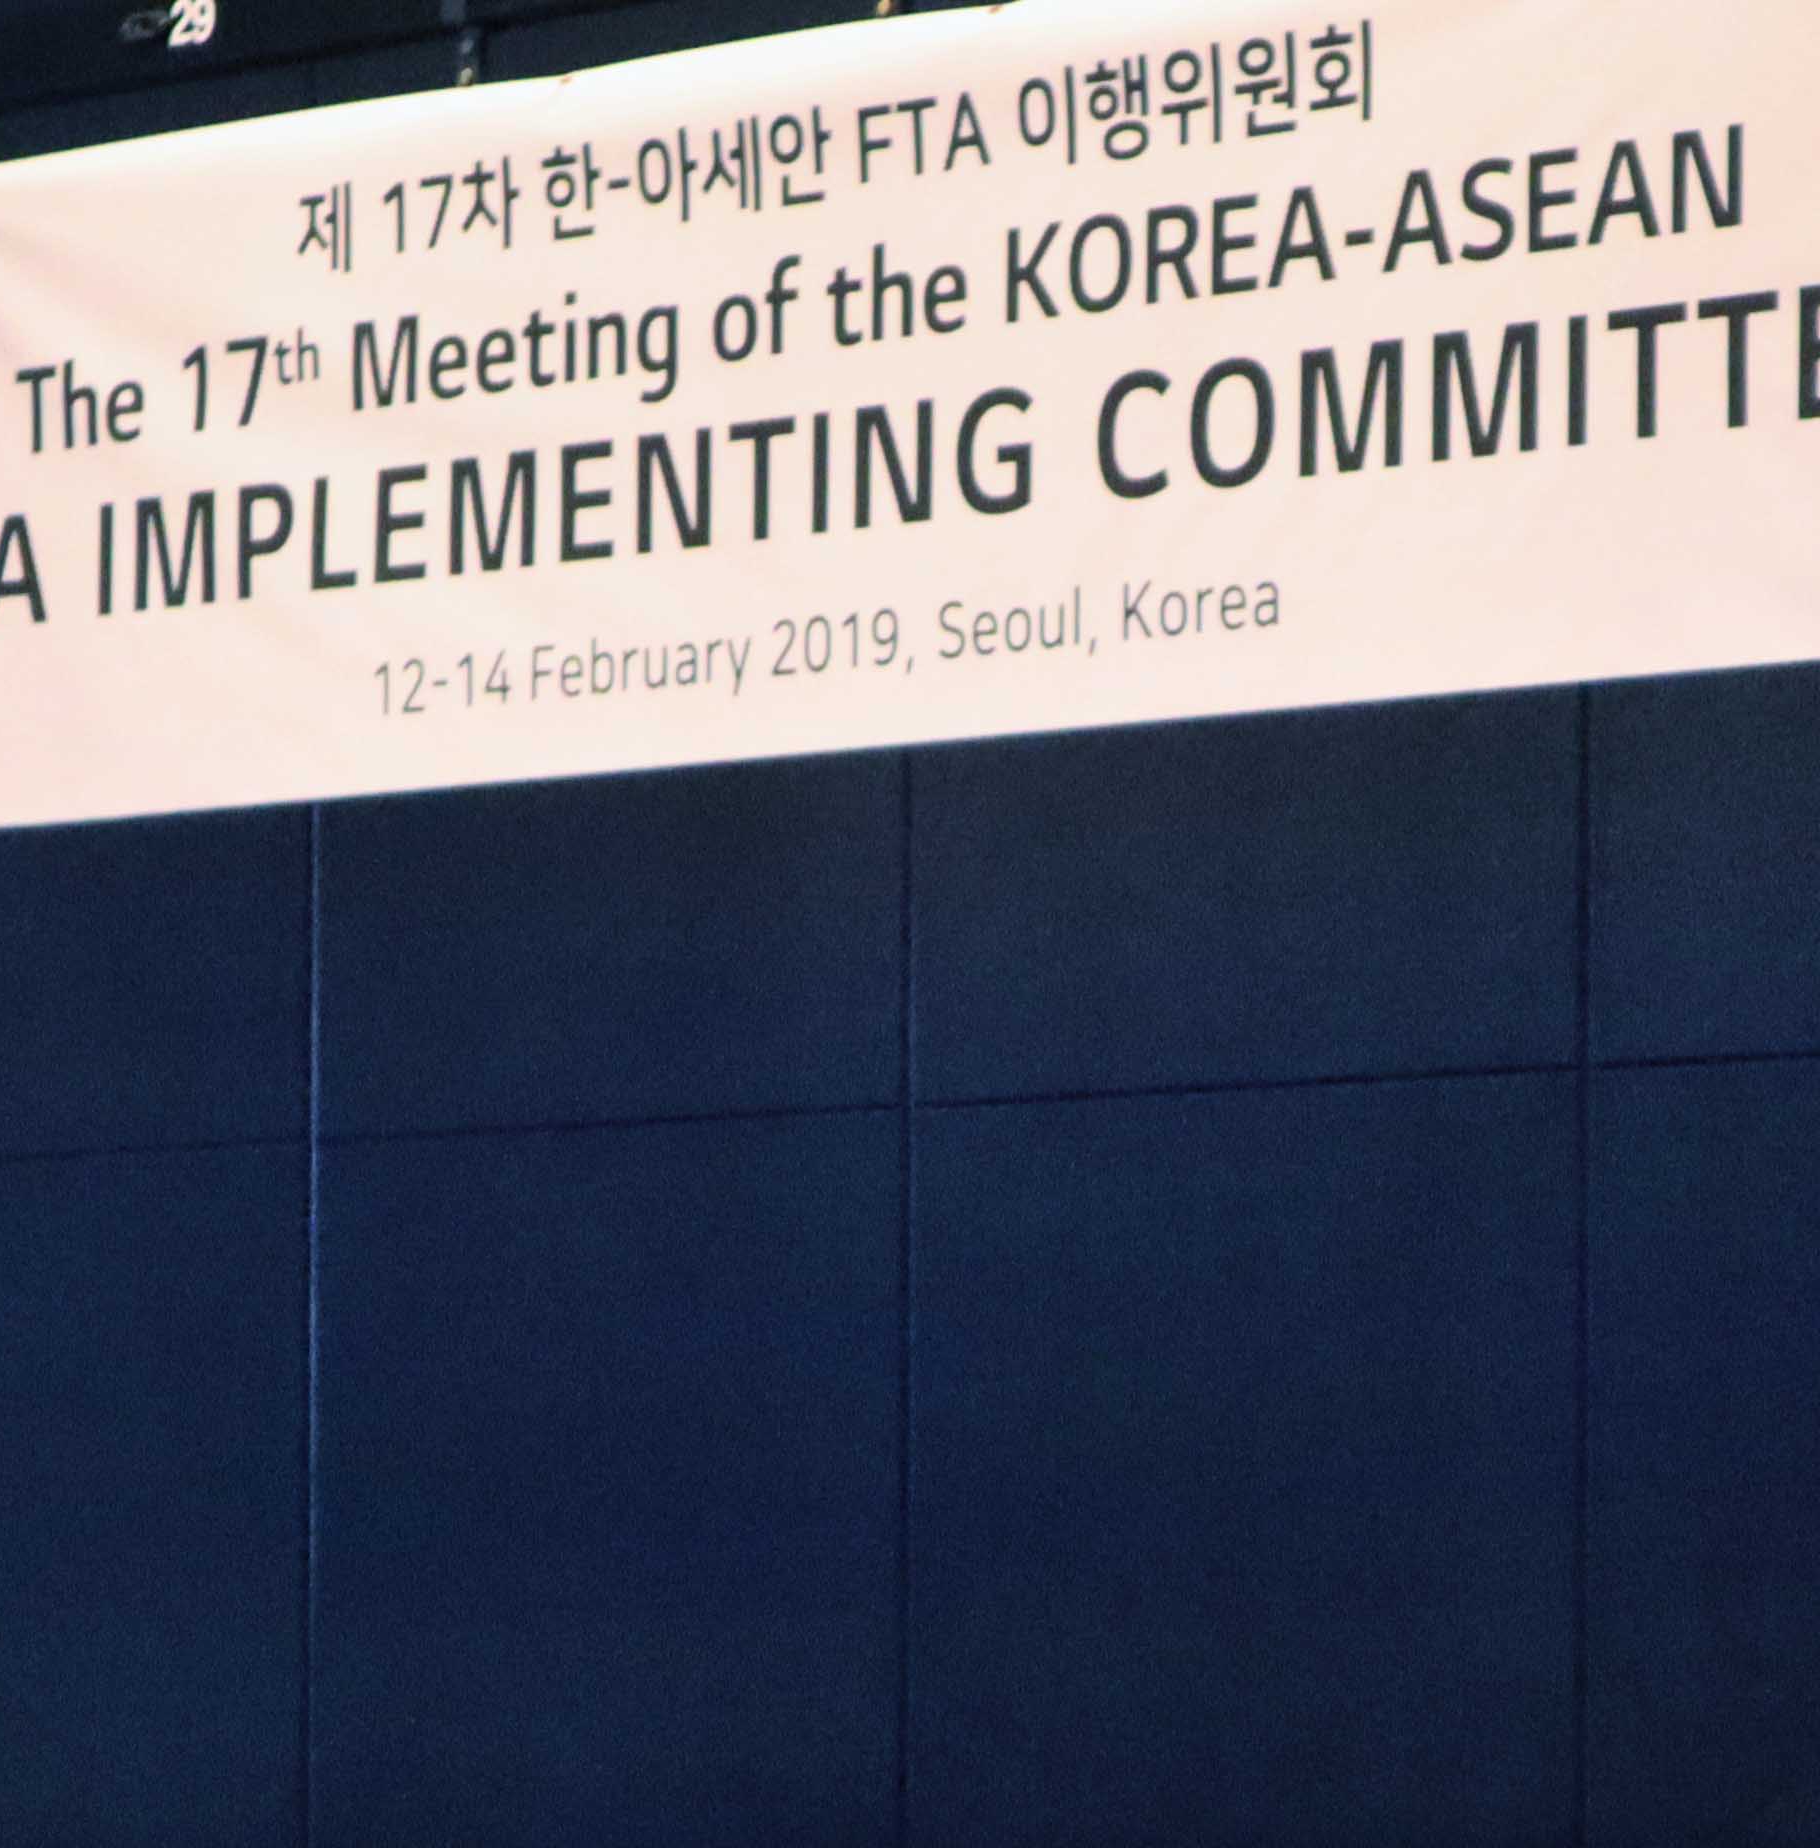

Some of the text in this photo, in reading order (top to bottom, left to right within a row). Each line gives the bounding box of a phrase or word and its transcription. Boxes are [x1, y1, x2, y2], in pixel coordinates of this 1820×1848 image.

[166, 0, 215, 47] 29
[296, 17, 1374, 274] 제 17차 한-아세안 FTA 이행위원회
[13, 122, 1745, 455] The 17th Meeting of the KOREA-ASEAN
[97, 385, 1034, 618] IMPLEMENTING
[374, 581, 1280, 714] 12-14 February 2019, Seoul, Korea
